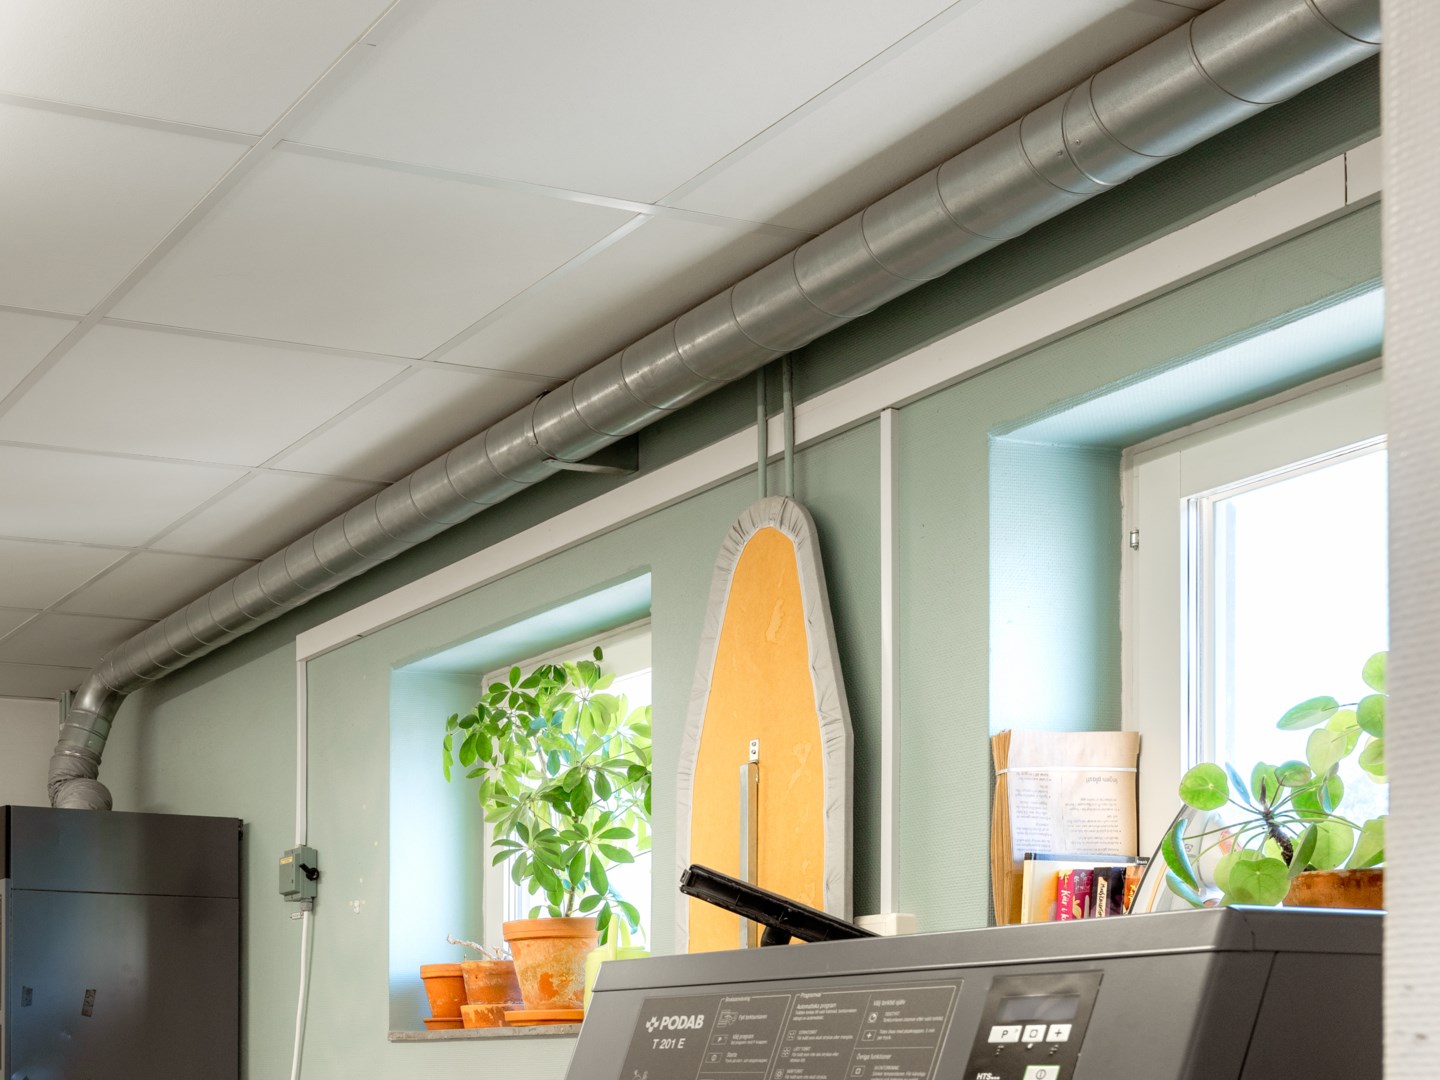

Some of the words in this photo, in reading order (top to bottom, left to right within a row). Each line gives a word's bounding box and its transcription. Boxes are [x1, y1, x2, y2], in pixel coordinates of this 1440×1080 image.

[659, 1014, 705, 1031] PODAB
[1001, 1030, 1009, 1039] P
[652, 1038, 659, 1049] T
[659, 1038, 676, 1049] 201
[677, 1038, 686, 1049] E
